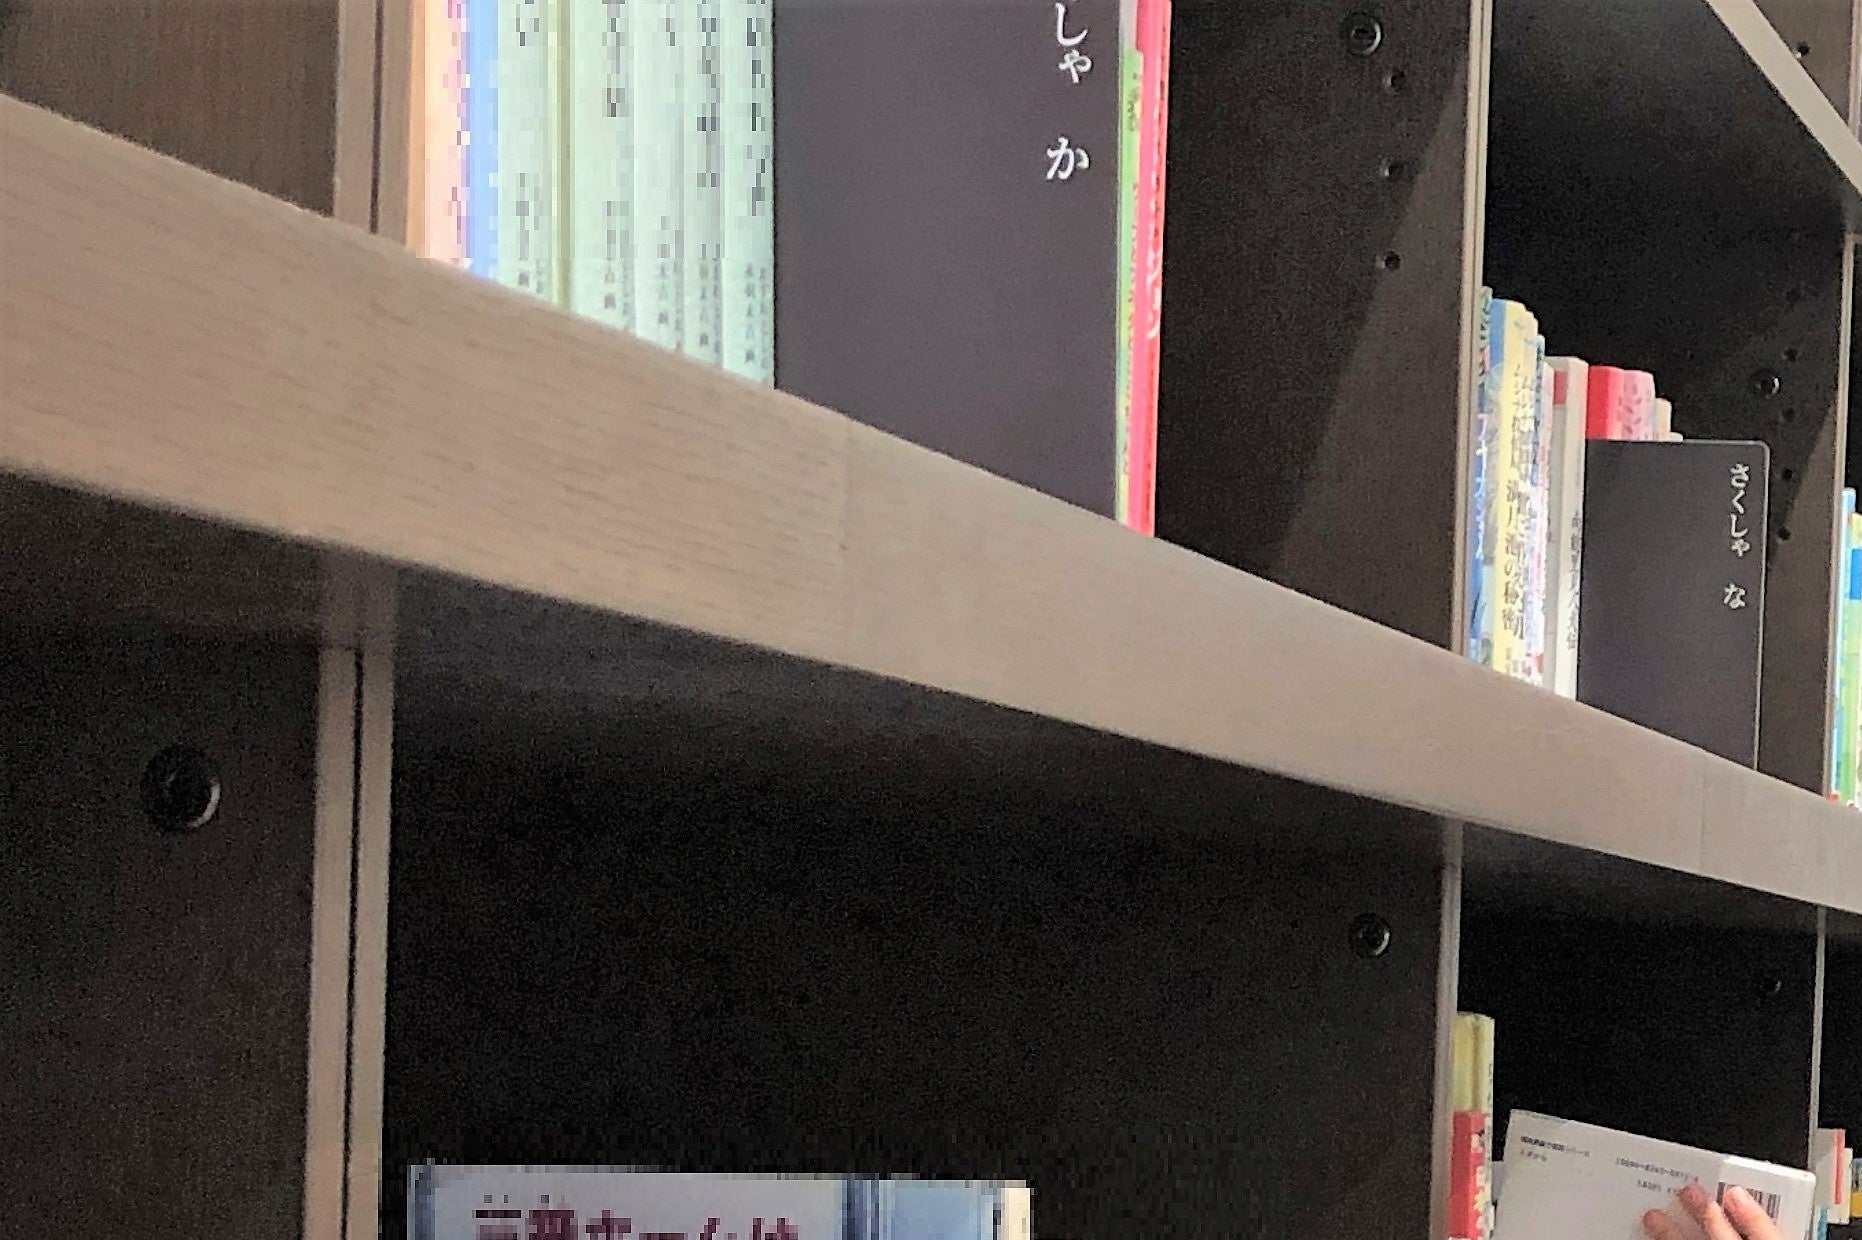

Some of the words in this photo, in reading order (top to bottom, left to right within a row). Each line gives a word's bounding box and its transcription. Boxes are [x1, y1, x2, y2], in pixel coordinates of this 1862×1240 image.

[1046, 136, 1090, 180] か
[1730, 463, 1751, 557] さくしゃ
[1723, 583, 1746, 609] な
